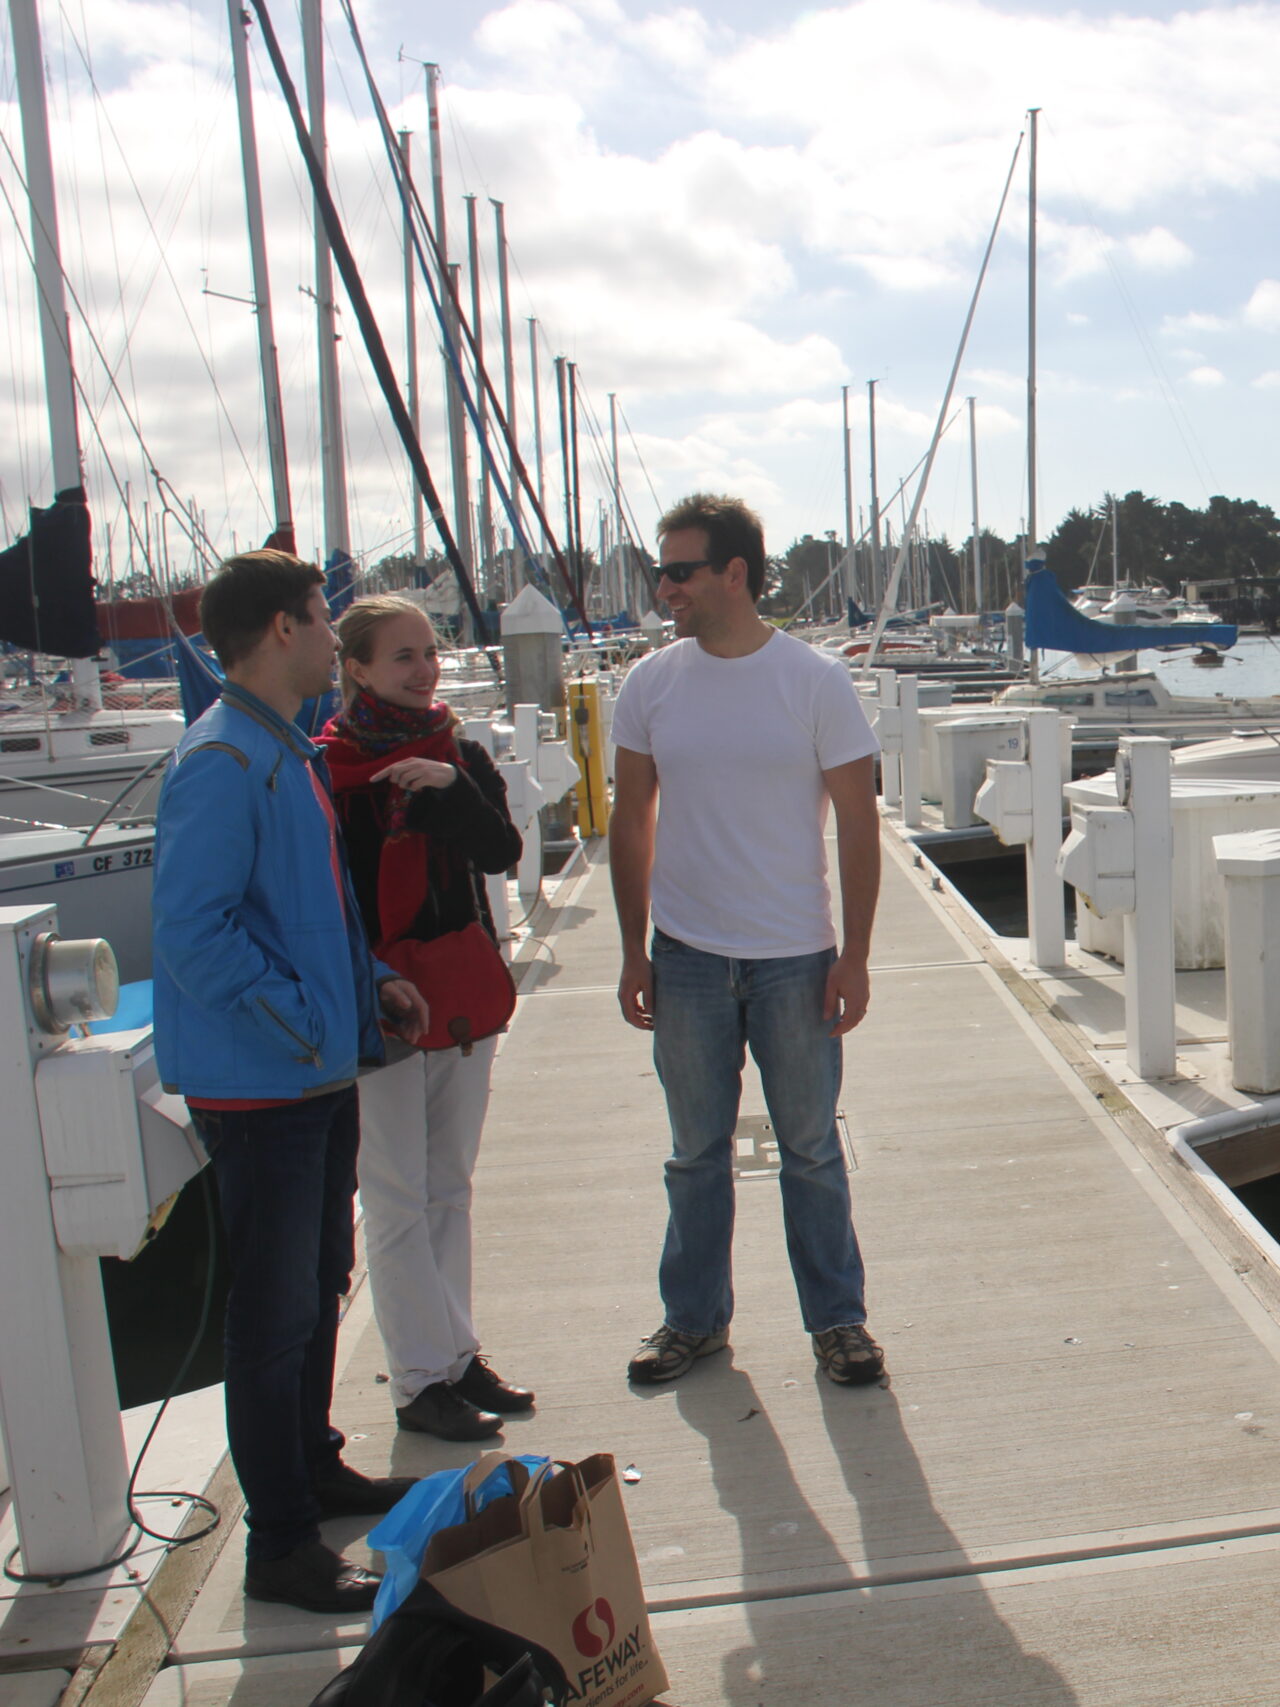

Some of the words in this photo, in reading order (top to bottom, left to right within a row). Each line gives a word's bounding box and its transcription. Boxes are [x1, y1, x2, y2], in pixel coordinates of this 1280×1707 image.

[1008, 738, 1019, 749] 19
[93, 855, 113, 872] CF
[558, 1624, 641, 1707] AFEWAY
[615, 1672, 629, 1689] for
